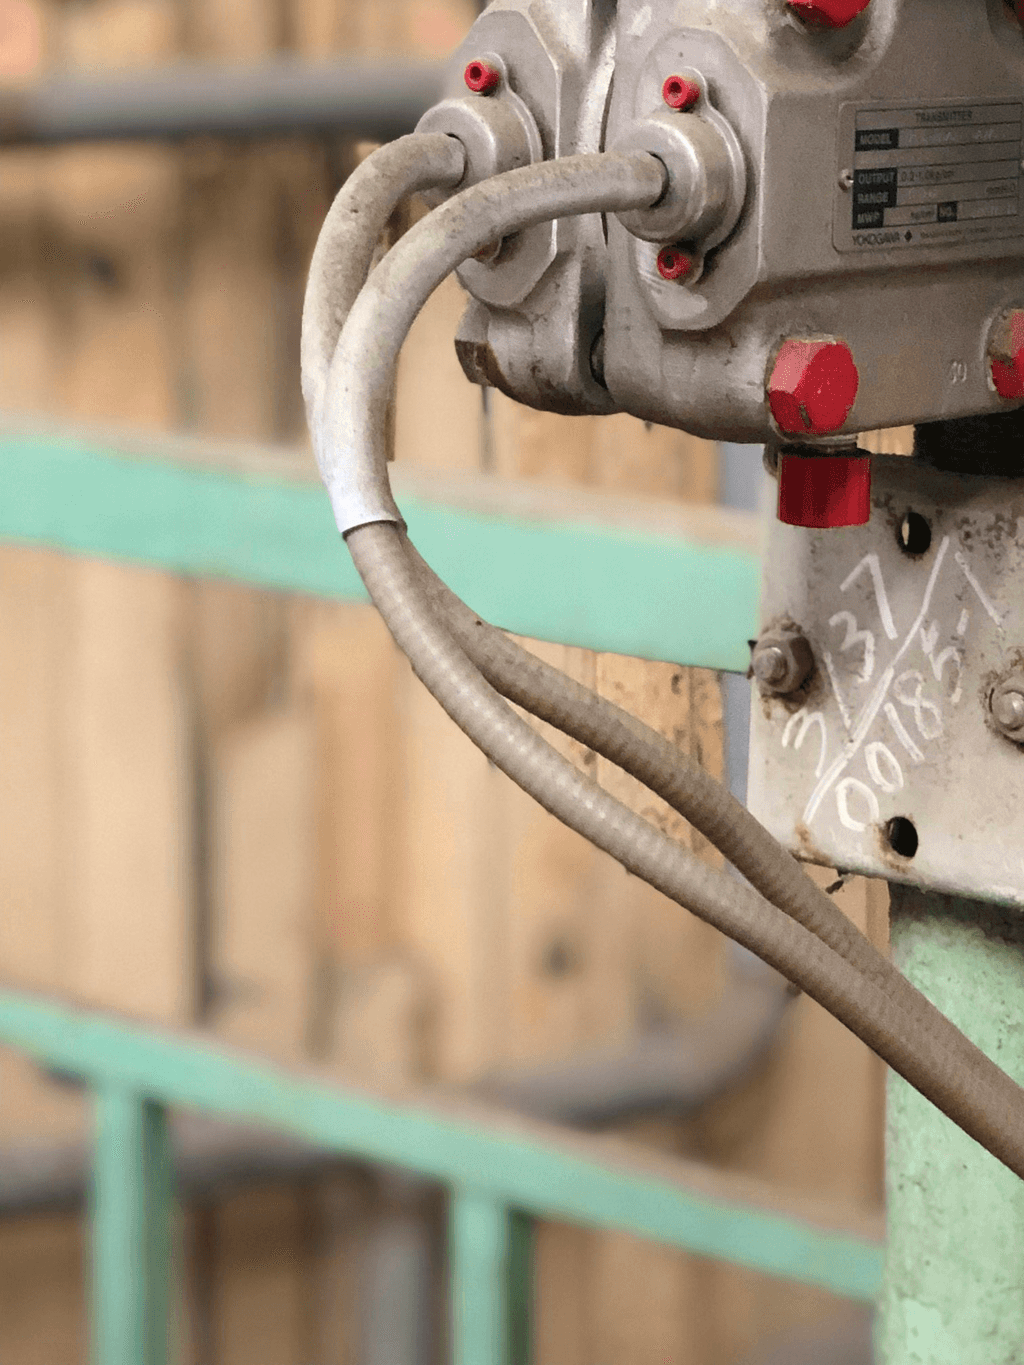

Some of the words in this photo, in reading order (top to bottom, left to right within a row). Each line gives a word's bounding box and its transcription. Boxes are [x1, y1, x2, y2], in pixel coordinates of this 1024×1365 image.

[915, 110, 973, 122] TRANSMITTER
[860, 133, 892, 145] MODEL
[858, 172, 895, 184] OUTPUT
[857, 191, 889, 204] RANGE
[857, 212, 880, 224] MWP
[852, 230, 900, 246] YOKOGAWA
